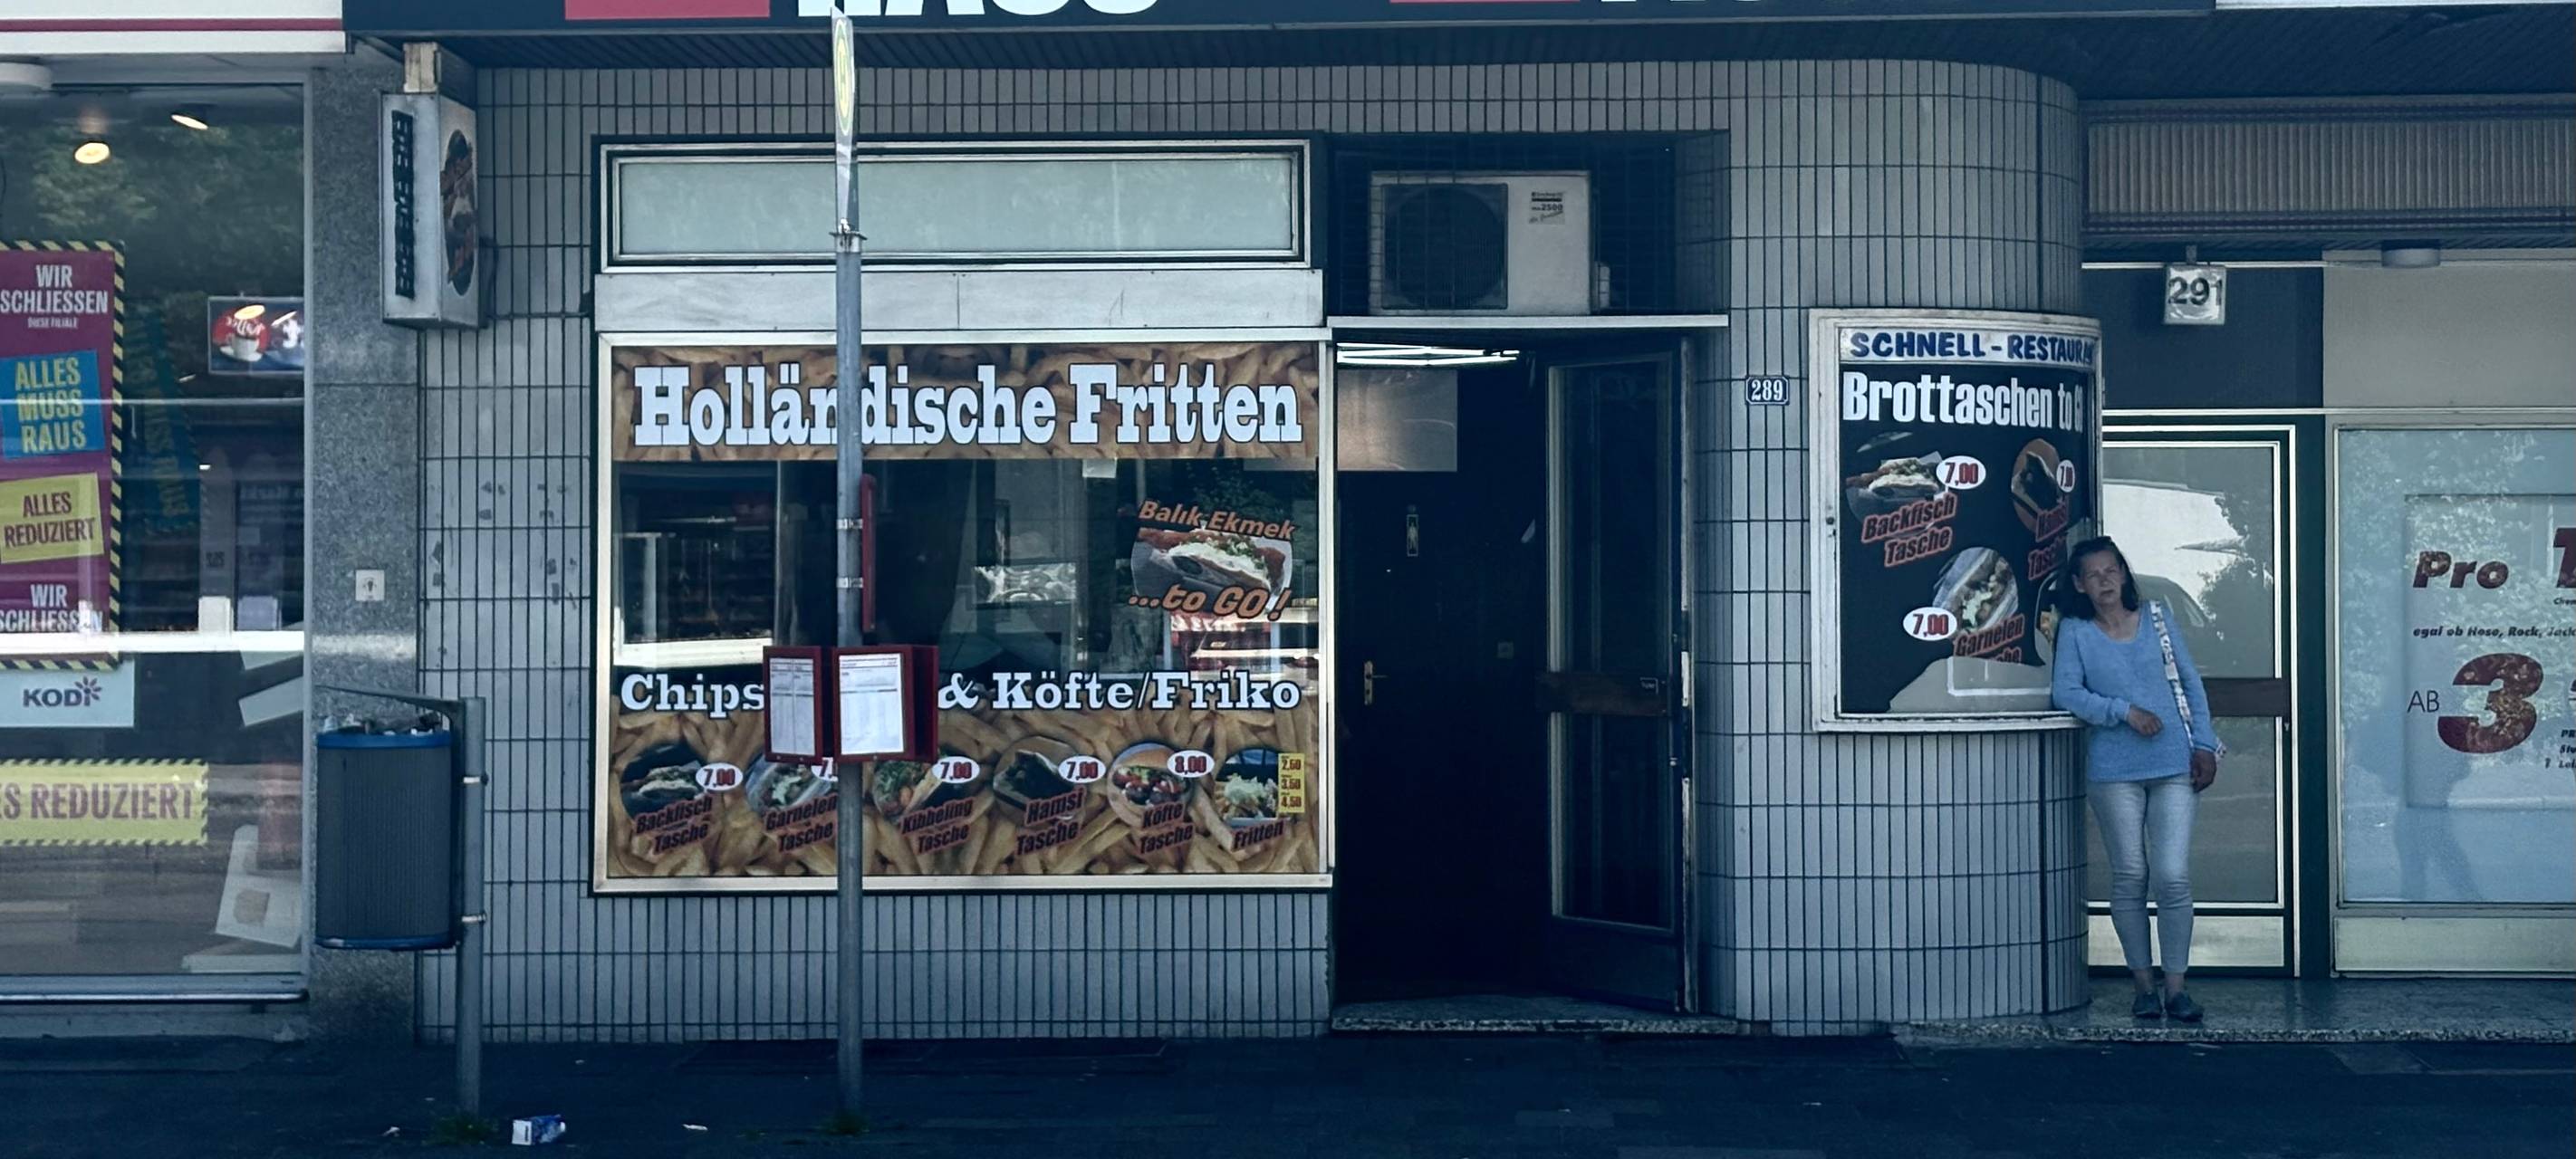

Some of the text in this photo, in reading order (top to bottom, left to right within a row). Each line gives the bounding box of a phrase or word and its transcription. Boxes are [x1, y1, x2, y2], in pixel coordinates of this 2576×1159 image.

[36, 263, 73, 288] WIR
[2167, 276, 2223, 306] 291
[0, 290, 109, 314] SCHLIESSEN
[1850, 331, 1986, 359] SCHNELL
[15, 357, 80, 390] ALLES
[17, 389, 84, 422] MUSS
[634, 362, 1302, 446] Holländische Fritten
[1750, 378, 1784, 402] 289
[1842, 371, 2052, 429] Brottaschen
[2058, 382, 2072, 432] to
[21, 421, 87, 453] RAUS
[1945, 462, 1979, 486] 7,00
[23, 492, 72, 519] ALLES
[1861, 493, 1957, 542] Backfisch
[4, 517, 96, 548] REDUZIERT
[1206, 511, 1295, 541] Ekmek
[1885, 527, 1952, 567] Tasche
[2412, 551, 2509, 589] Pro
[30, 584, 68, 608] WIR
[1912, 614, 1950, 637] 7,00
[1954, 616, 2024, 657] Garnelen
[2413, 625, 2444, 638] egal
[2446, 625, 2464, 637] ob
[620, 673, 764, 718] Chips
[937, 672, 979, 710] &
[992, 670, 1302, 711] Köfte/Friko
[2407, 652, 2544, 754] AB 3
[703, 768, 735, 789] 7,00
[940, 761, 973, 781] 7,00
[1066, 761, 1099, 781] 7,00
[0, 782, 196, 819] S REDUZIERT
[636, 796, 713, 835] Backfisch
[1025, 787, 1084, 826] Hamsi
[1142, 803, 1184, 829] Köfte
[653, 822, 709, 853] Tasche
[778, 821, 834, 852] Tasche
[918, 823, 970, 854] Tasche
[1016, 820, 1079, 856] Tasche
[1139, 825, 1194, 855] Tasche
[1233, 819, 1284, 850] Fritten
